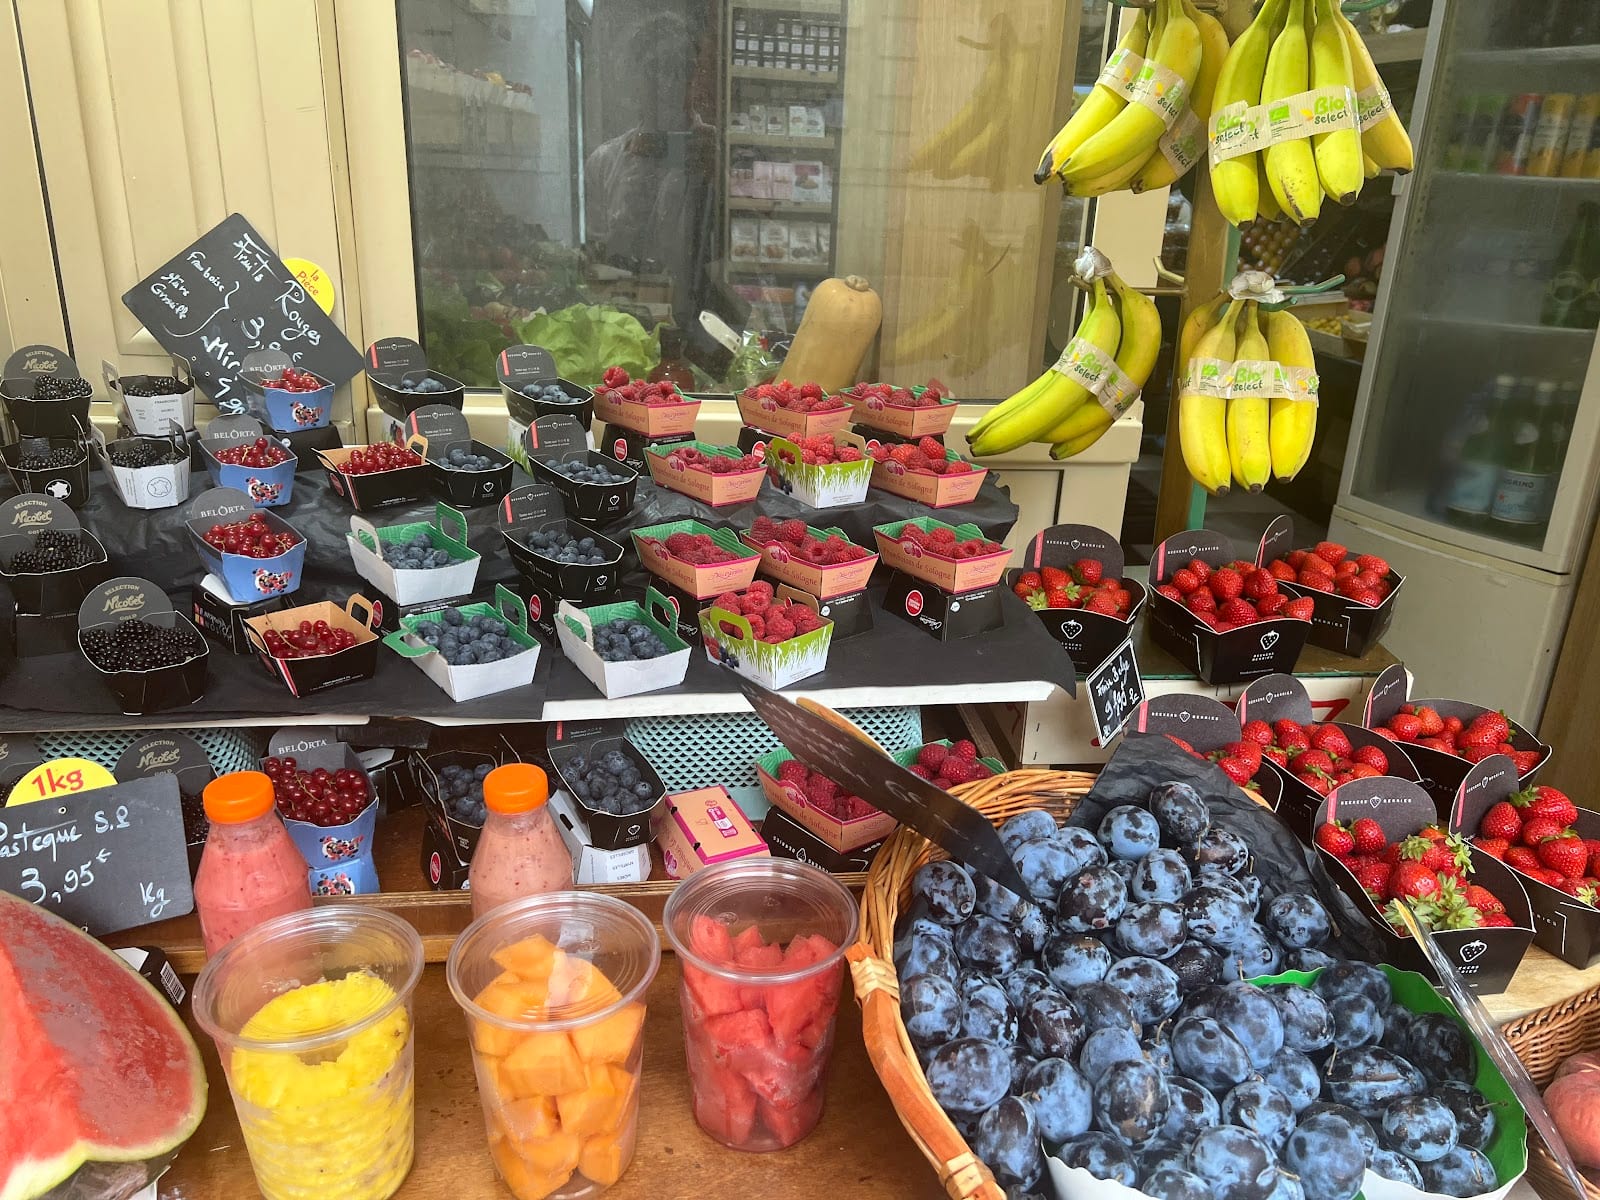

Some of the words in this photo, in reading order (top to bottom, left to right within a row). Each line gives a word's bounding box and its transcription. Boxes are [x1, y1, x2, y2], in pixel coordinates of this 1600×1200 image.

[1314, 96, 1345, 115] Bio
[1314, 109, 1348, 125] select
[1215, 122, 1244, 144] select
[1170, 143, 1192, 168] select
[187, 251, 226, 292] Framboise
[310, 269, 320, 282] la
[233, 232, 274, 283] Fruits
[275, 280, 322, 346] Rouges
[296, 271, 320, 297] Pièce
[1074, 364, 1100, 382] select
[1233, 380, 1263, 392] select
[13, 500, 48, 509] SELECTION
[104, 584, 140, 595] SELECTION
[139, 739, 176, 753] SELECTION
[31, 768, 85, 798] 1kg
